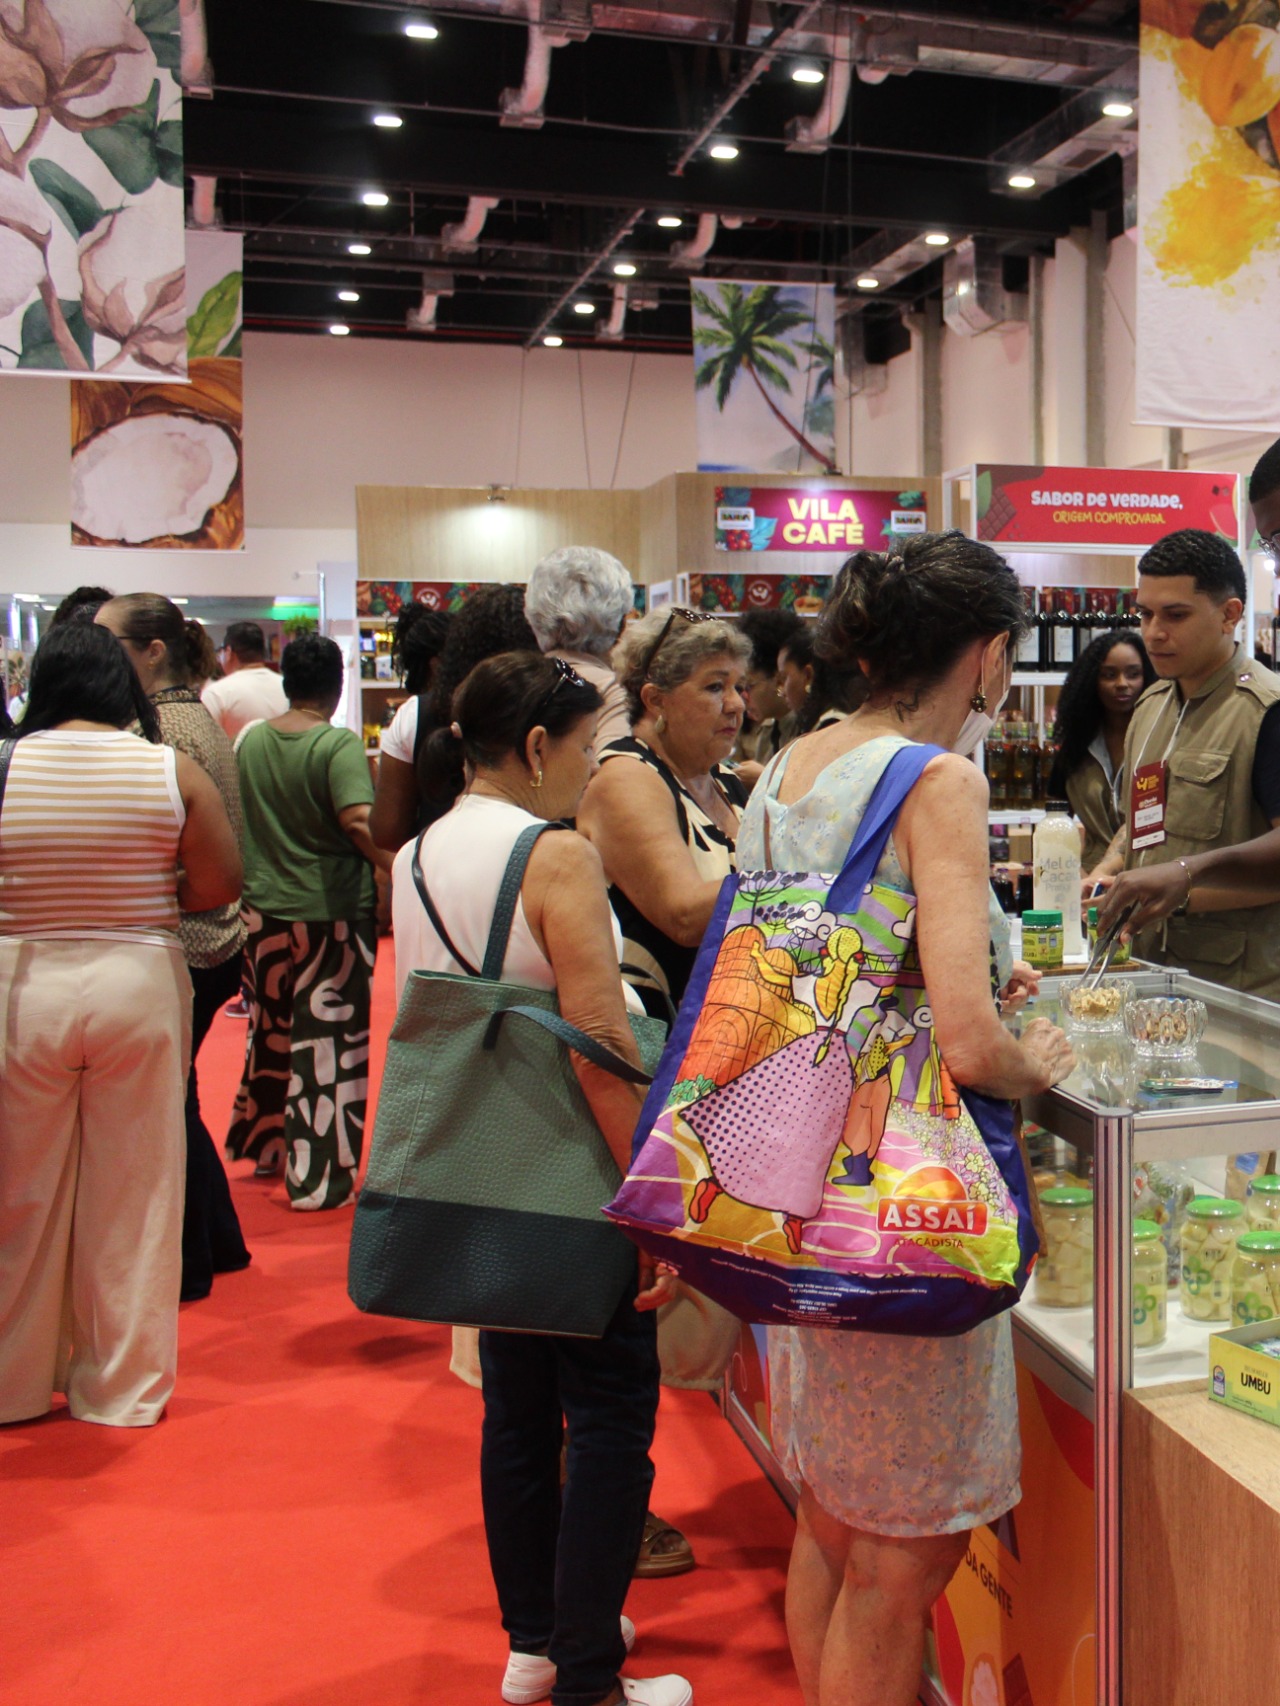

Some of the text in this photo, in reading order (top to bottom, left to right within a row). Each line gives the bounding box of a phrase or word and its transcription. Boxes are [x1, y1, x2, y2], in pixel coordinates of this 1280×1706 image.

[787, 498, 858, 521] VILA
[1031, 490, 1084, 506] SABOR
[1052, 511, 1093, 525] ORIGEM
[782, 518, 865, 545] CAFÉ
[894, 1237, 964, 1249] ATACADISTA
[1240, 1371, 1272, 1396] UMBU
[979, 1562, 1014, 1620] GENTE
